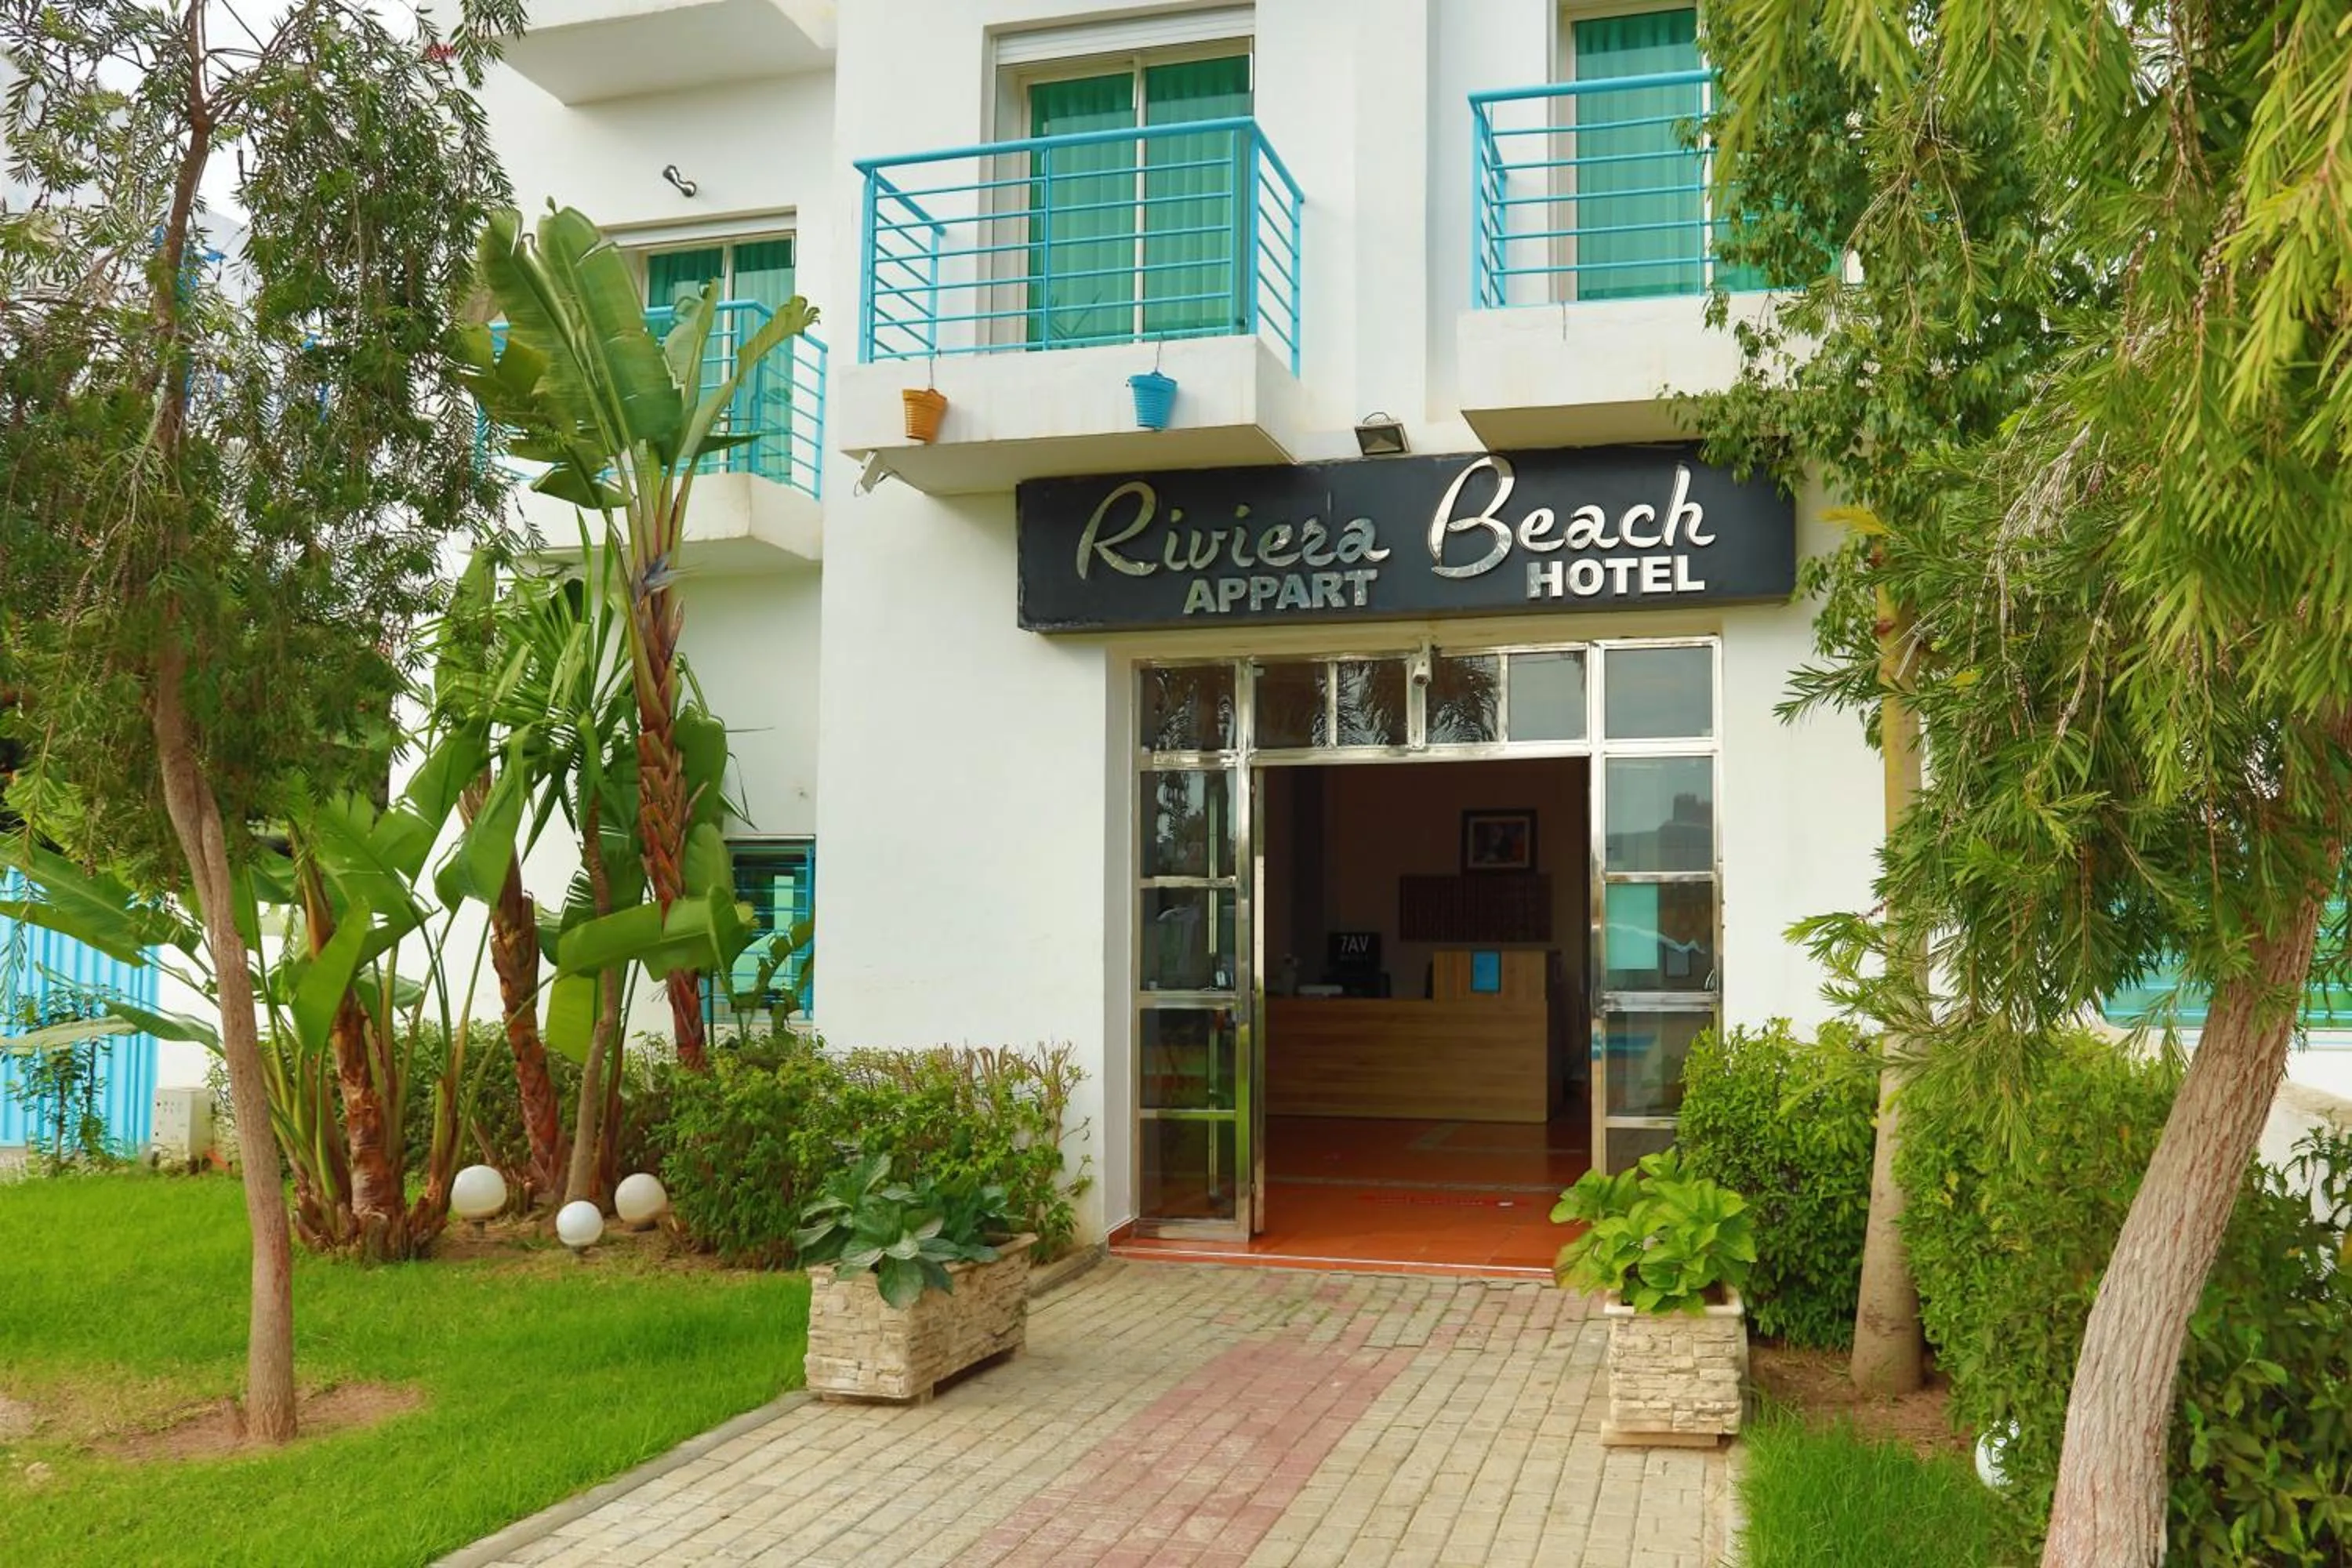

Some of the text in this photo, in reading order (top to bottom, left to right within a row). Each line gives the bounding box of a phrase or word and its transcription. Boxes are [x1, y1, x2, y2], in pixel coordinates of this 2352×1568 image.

[1076, 455, 1716, 580] Riviera Beach
[1182, 554, 1706, 615] APPART HOTEL
